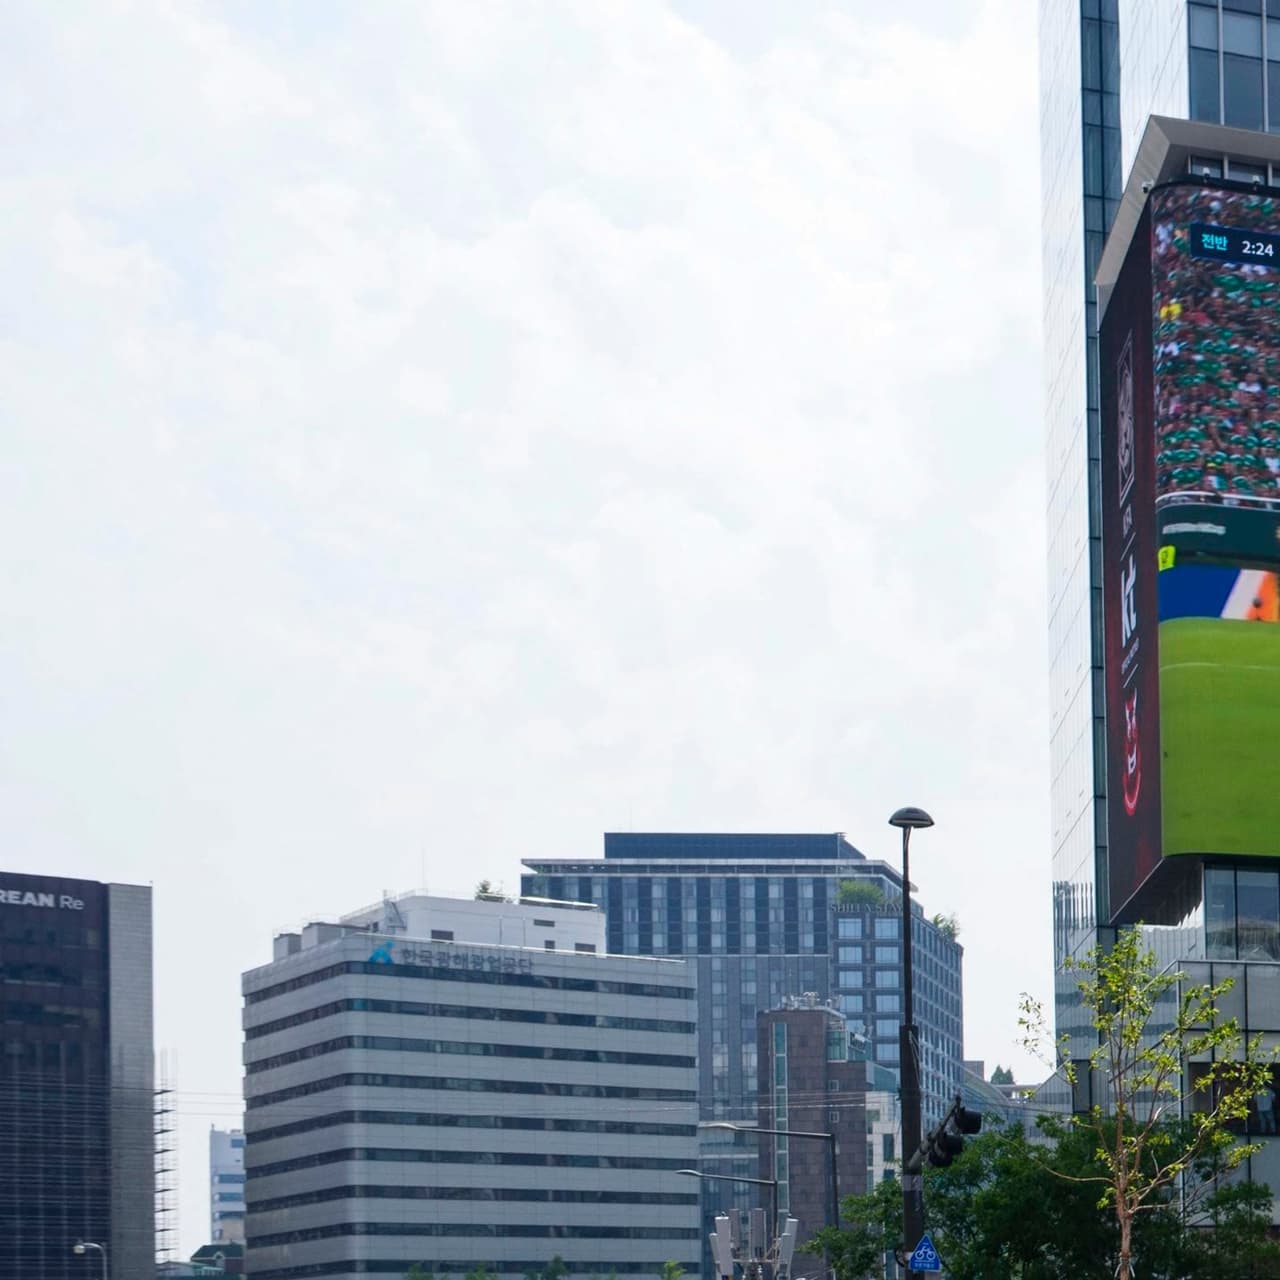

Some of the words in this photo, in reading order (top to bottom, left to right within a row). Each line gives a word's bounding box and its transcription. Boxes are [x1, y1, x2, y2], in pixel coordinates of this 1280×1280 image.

[1202, 231, 1228, 249] 전반
[1241, 238, 1274, 254] 2:24
[60, 895, 85, 911] Re
